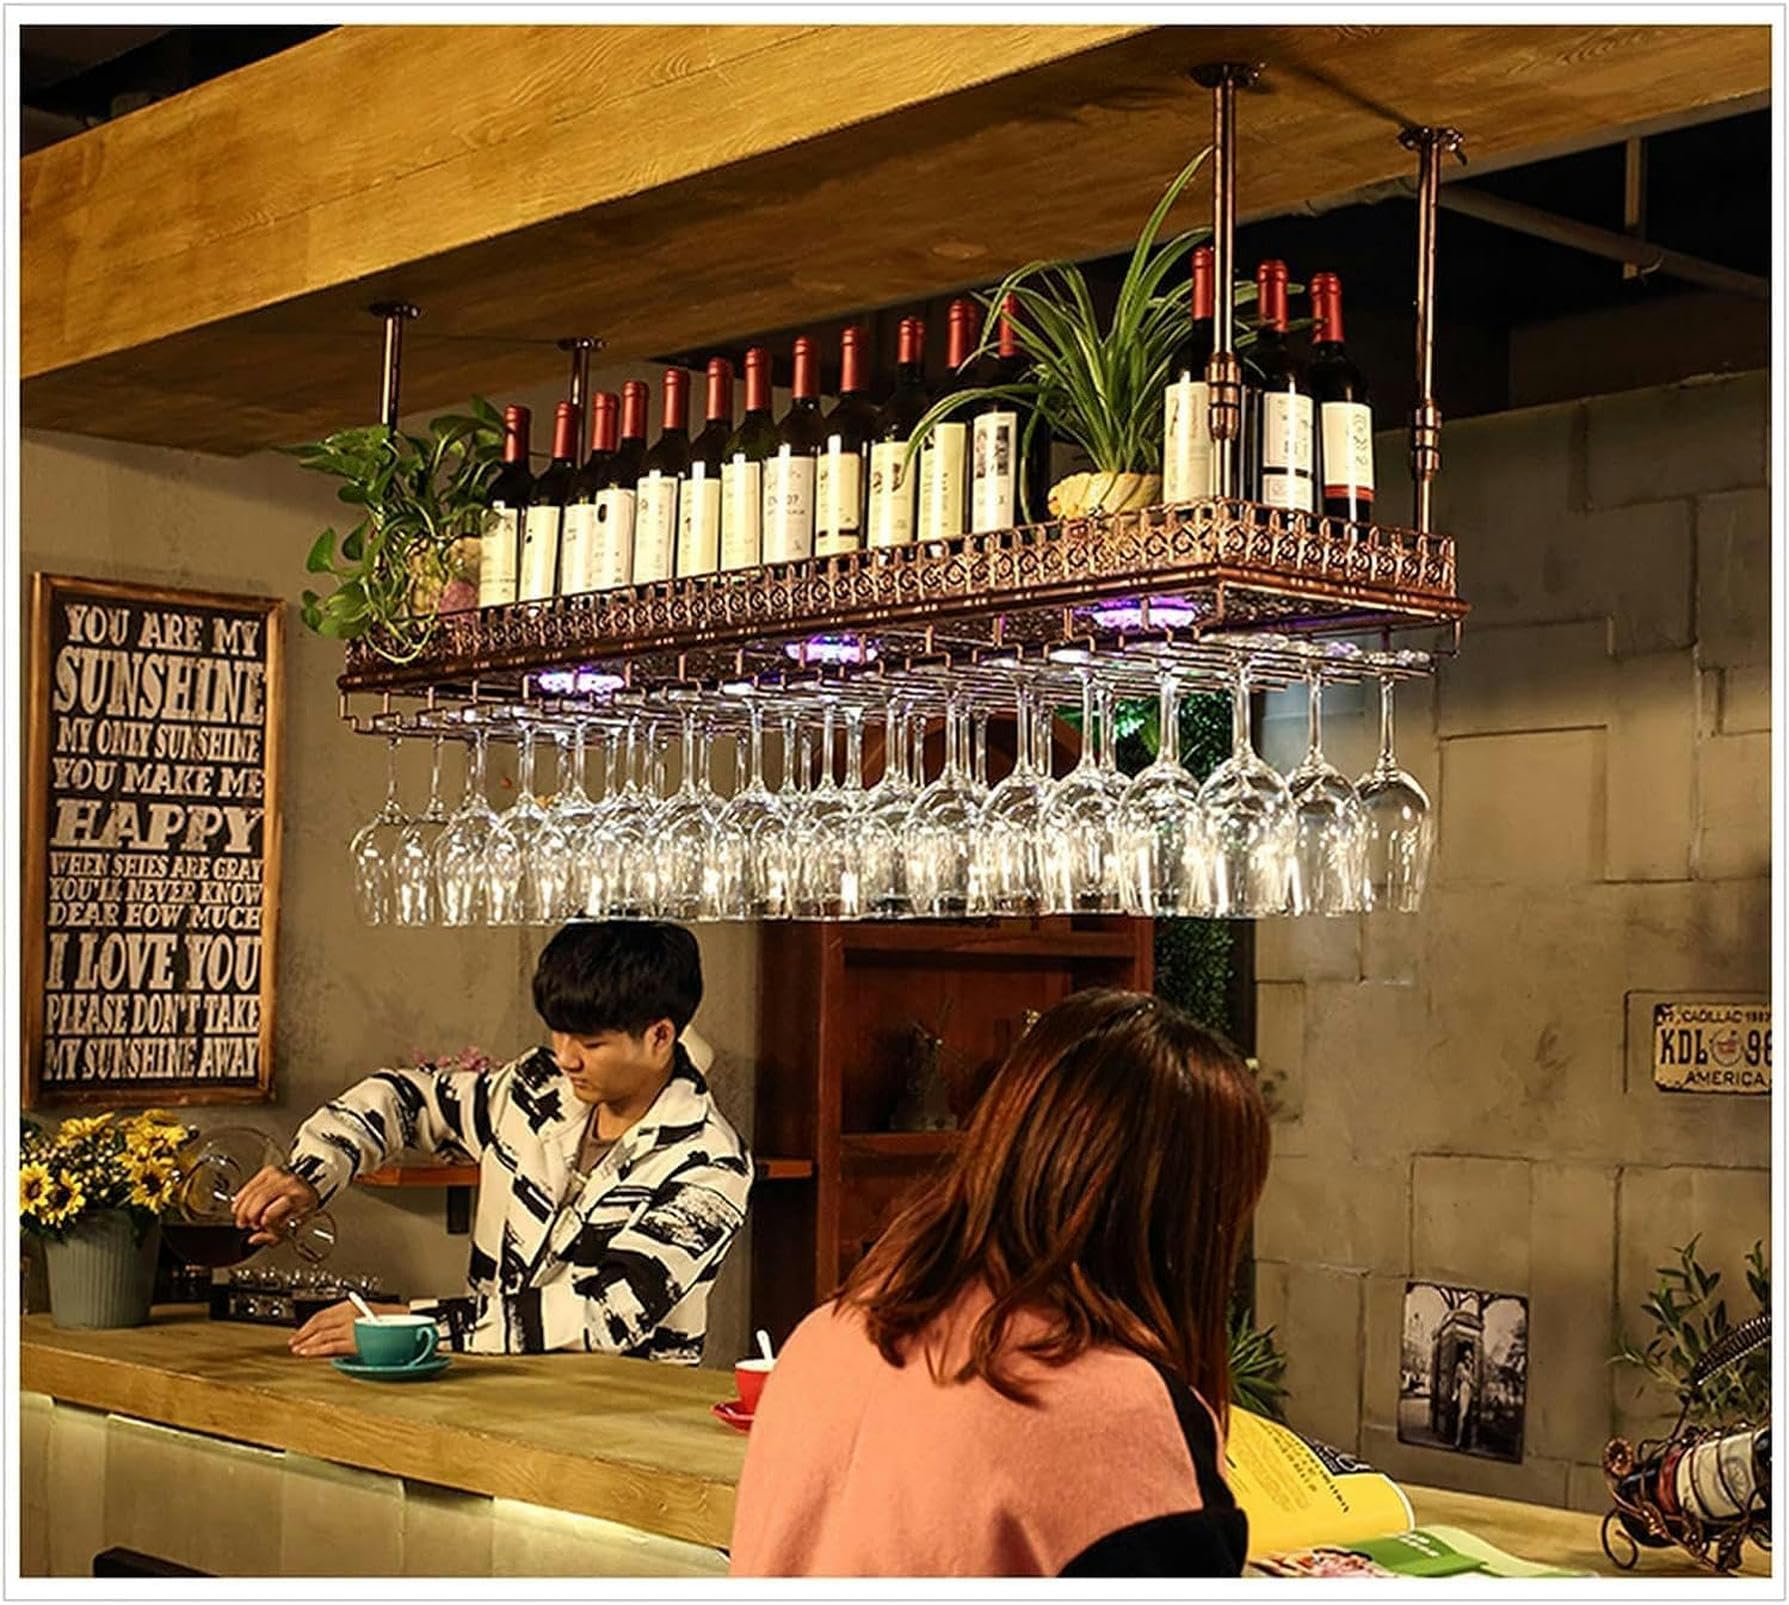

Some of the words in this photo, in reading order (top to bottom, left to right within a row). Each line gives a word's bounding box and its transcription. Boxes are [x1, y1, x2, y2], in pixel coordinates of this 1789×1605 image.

[65, 604, 130, 646] YOU
[138, 611, 202, 651] ARE
[212, 617, 260, 656] MY
[53, 645, 266, 725] SUNSHINE
[56, 716, 94, 752] MY
[96, 720, 153, 757] ONLY
[154, 724, 261, 762] SUNSHINE
[53, 757, 117, 790] YOU
[121, 763, 214, 798] MAKE
[217, 768, 265, 799] ME
[50, 799, 265, 853] HAPPY
[50, 851, 110, 876] WHEN
[170, 857, 210, 880] ARE
[213, 858, 264, 881] GRAY
[49, 877, 121, 901] YOU'LL
[125, 880, 195, 903] NEVER
[199, 882, 263, 905] KNOW
[48, 901, 119, 927] DEAR
[124, 904, 183, 928] HOW
[186, 905, 263, 929] MUCH
[46, 932, 69, 990] I
[75, 932, 178, 990] LOVE
[184, 934, 262, 991] YOU
[46, 994, 129, 1035] PLEASE
[131, 993, 201, 1034] DON'T
[203, 994, 260, 1034] TAKE
[44, 1038, 83, 1080] MY
[83, 1038, 195, 1080] SUNSHINE
[197, 1037, 260, 1077] AWAY
[1660, 1029, 1708, 1065] KDL
[1683, 1071, 1768, 1087] AMERICA
